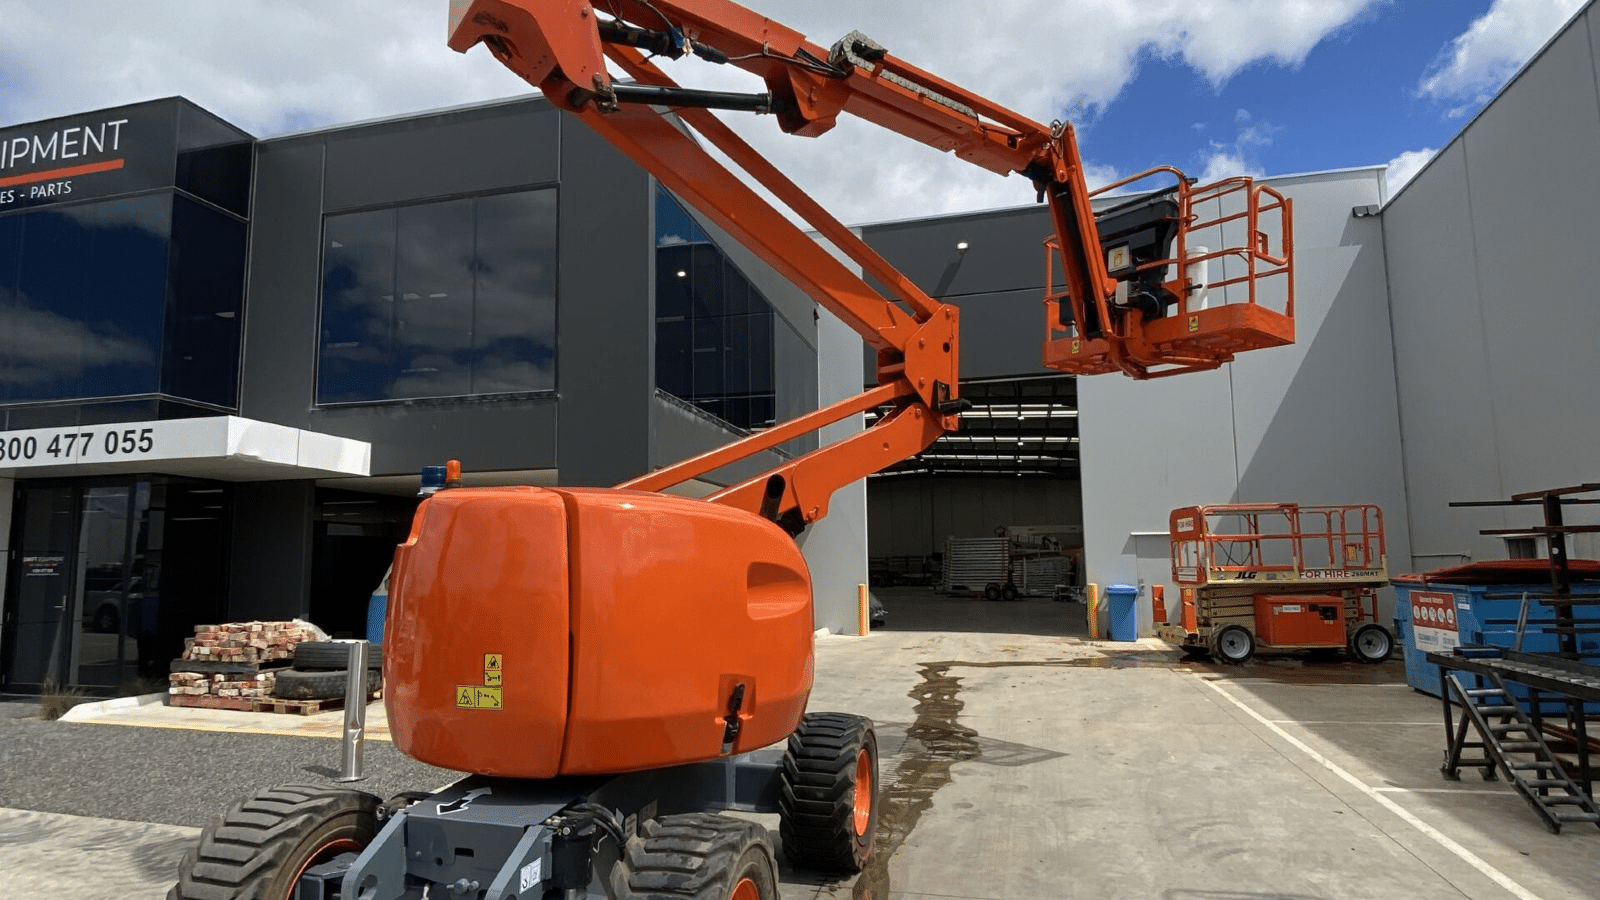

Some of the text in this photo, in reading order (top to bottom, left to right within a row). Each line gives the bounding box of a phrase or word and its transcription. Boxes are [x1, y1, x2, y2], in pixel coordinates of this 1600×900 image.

[1, 119, 128, 169] IPMENT
[0, 190, 15, 204] ES
[30, 181, 72, 198] PARTS
[46, 433, 94, 457] 477
[105, 428, 153, 454] 055
[1235, 571, 1257, 579] JLG
[1300, 570, 1350, 578] FOR HIRE
